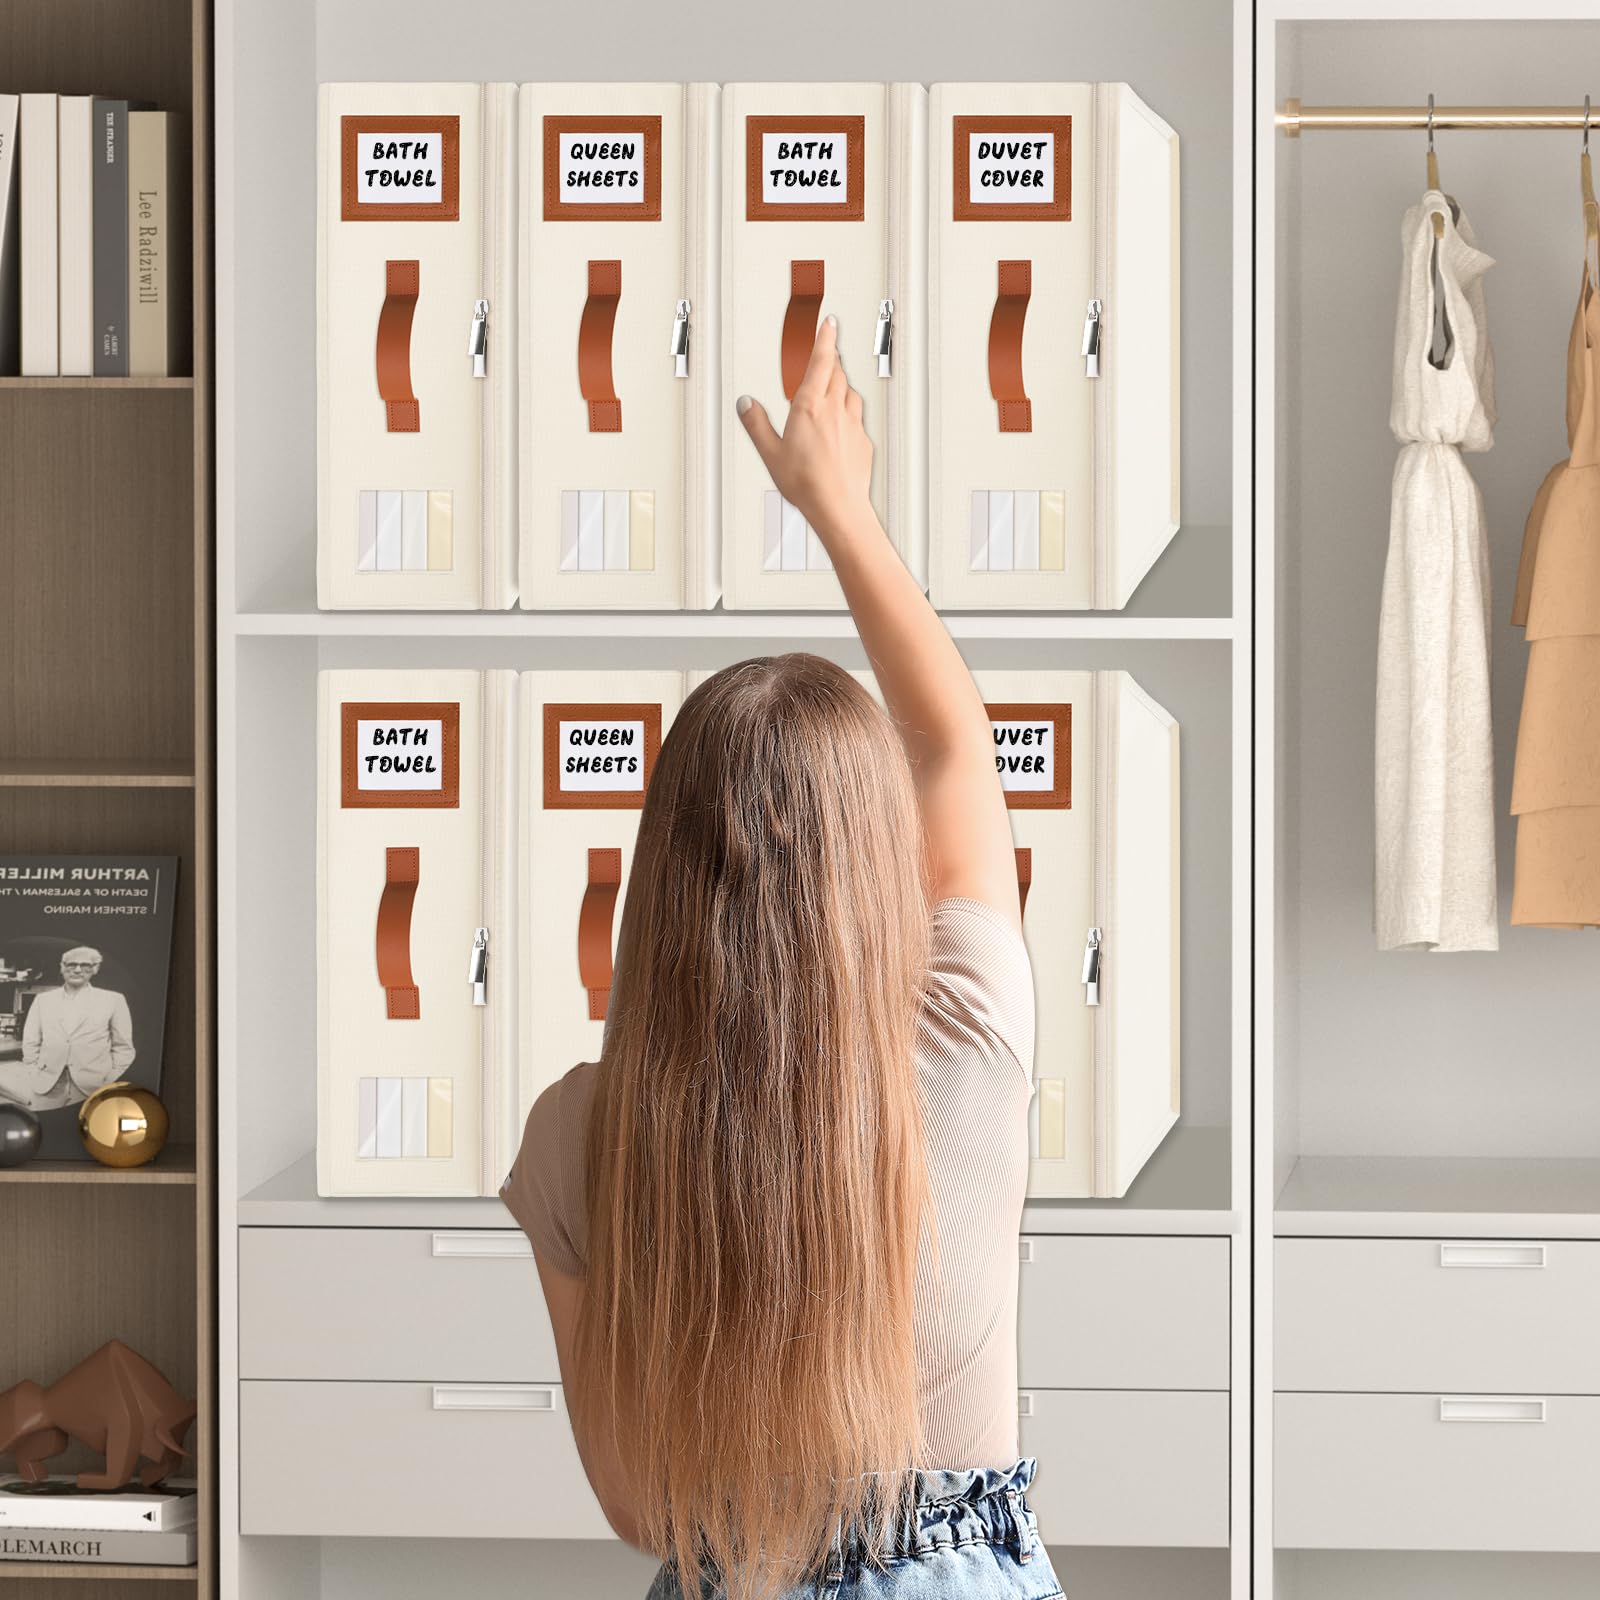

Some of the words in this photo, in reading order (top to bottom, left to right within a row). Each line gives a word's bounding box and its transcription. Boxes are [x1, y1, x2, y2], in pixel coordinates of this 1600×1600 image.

[106, 112, 114, 127] THE
[106, 127, 114, 164] STRANGER
[373, 141, 428, 160] BATH
[570, 142, 635, 160] QUEEN
[777, 141, 834, 160] BATH
[978, 141, 1048, 160] DUVET
[365, 169, 436, 187] TOWEL
[567, 170, 639, 188] SHEETS
[770, 169, 841, 187] TOWEL
[980, 169, 1044, 187] COVER
[139, 191, 157, 219] Lee
[139, 226, 158, 304] Radziwill
[373, 728, 429, 746] BATH
[569, 728, 634, 746] QUEEN
[993, 727, 1048, 746] UVET
[365, 755, 436, 773] TOWEL
[566, 756, 638, 774] SHEETS
[995, 755, 1045, 773] OVER
[0, 1538, 102, 1556] LEMARCH
